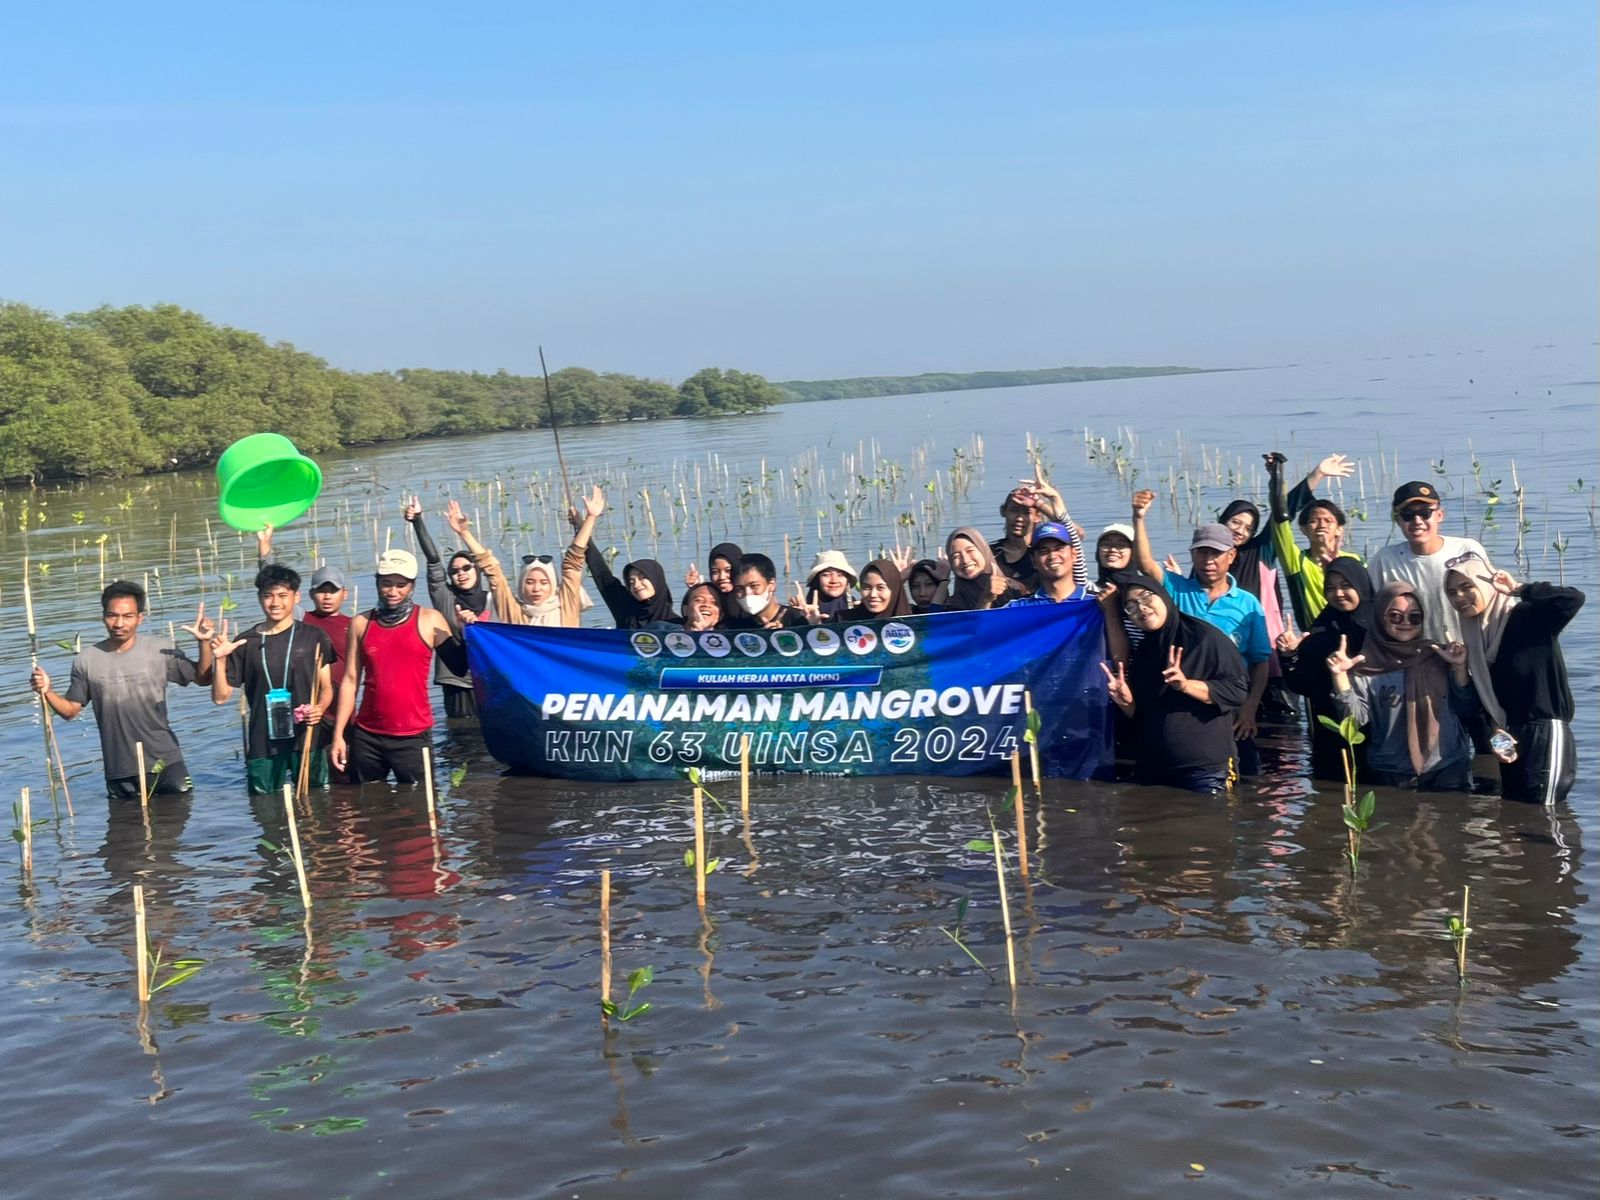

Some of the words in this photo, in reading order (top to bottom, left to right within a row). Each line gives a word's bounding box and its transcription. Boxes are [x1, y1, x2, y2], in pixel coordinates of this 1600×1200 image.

[698, 674, 735, 683] KULIAH
[737, 674, 769, 683] KERJA
[770, 673, 806, 682] NYATA
[808, 672, 840, 683] (KKN)
[542, 693, 783, 721] PENANAMAN
[789, 684, 1024, 721] MANGROVE
[545, 730, 633, 762] KKN
[648, 731, 706, 762] 63
[721, 730, 873, 764] UINSA
[890, 726, 1018, 762] 2024
